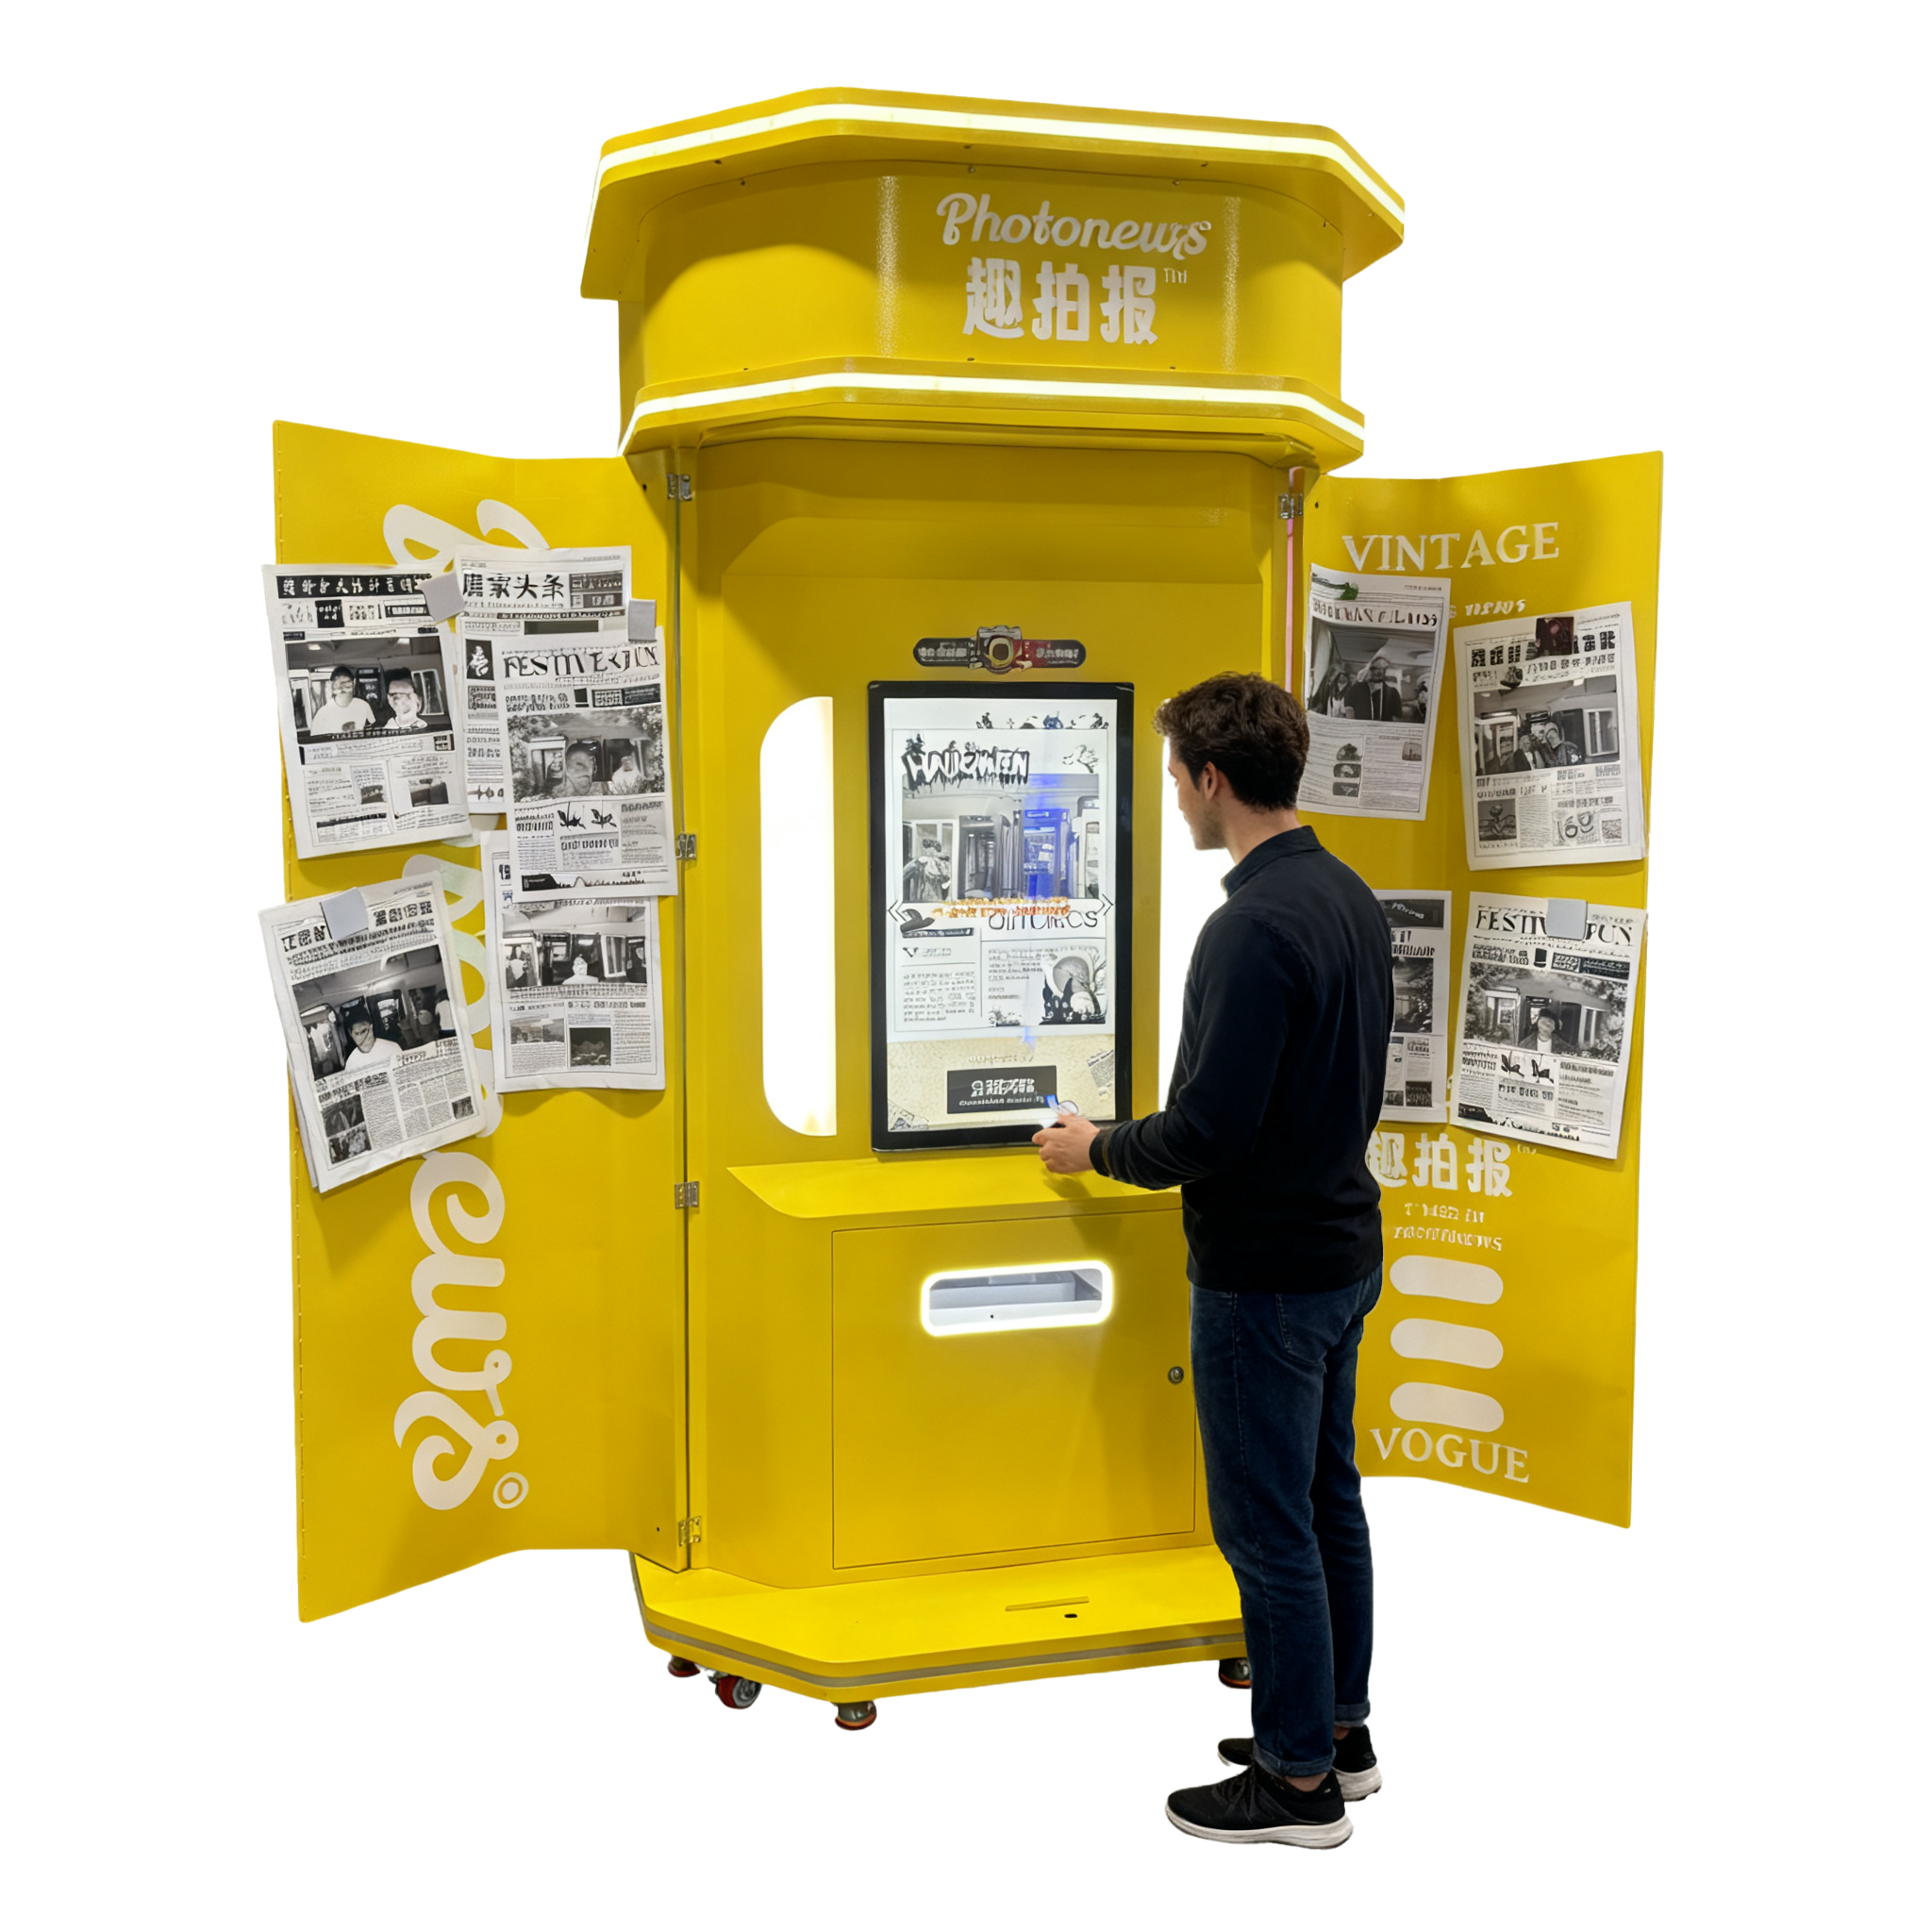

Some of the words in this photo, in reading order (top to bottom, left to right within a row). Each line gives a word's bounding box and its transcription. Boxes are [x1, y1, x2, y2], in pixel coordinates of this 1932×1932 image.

[962, 257, 1158, 344] 趣拍报
[1342, 522, 1559, 572] VINTAGE
[1370, 1427, 1529, 1483] VOGUE
